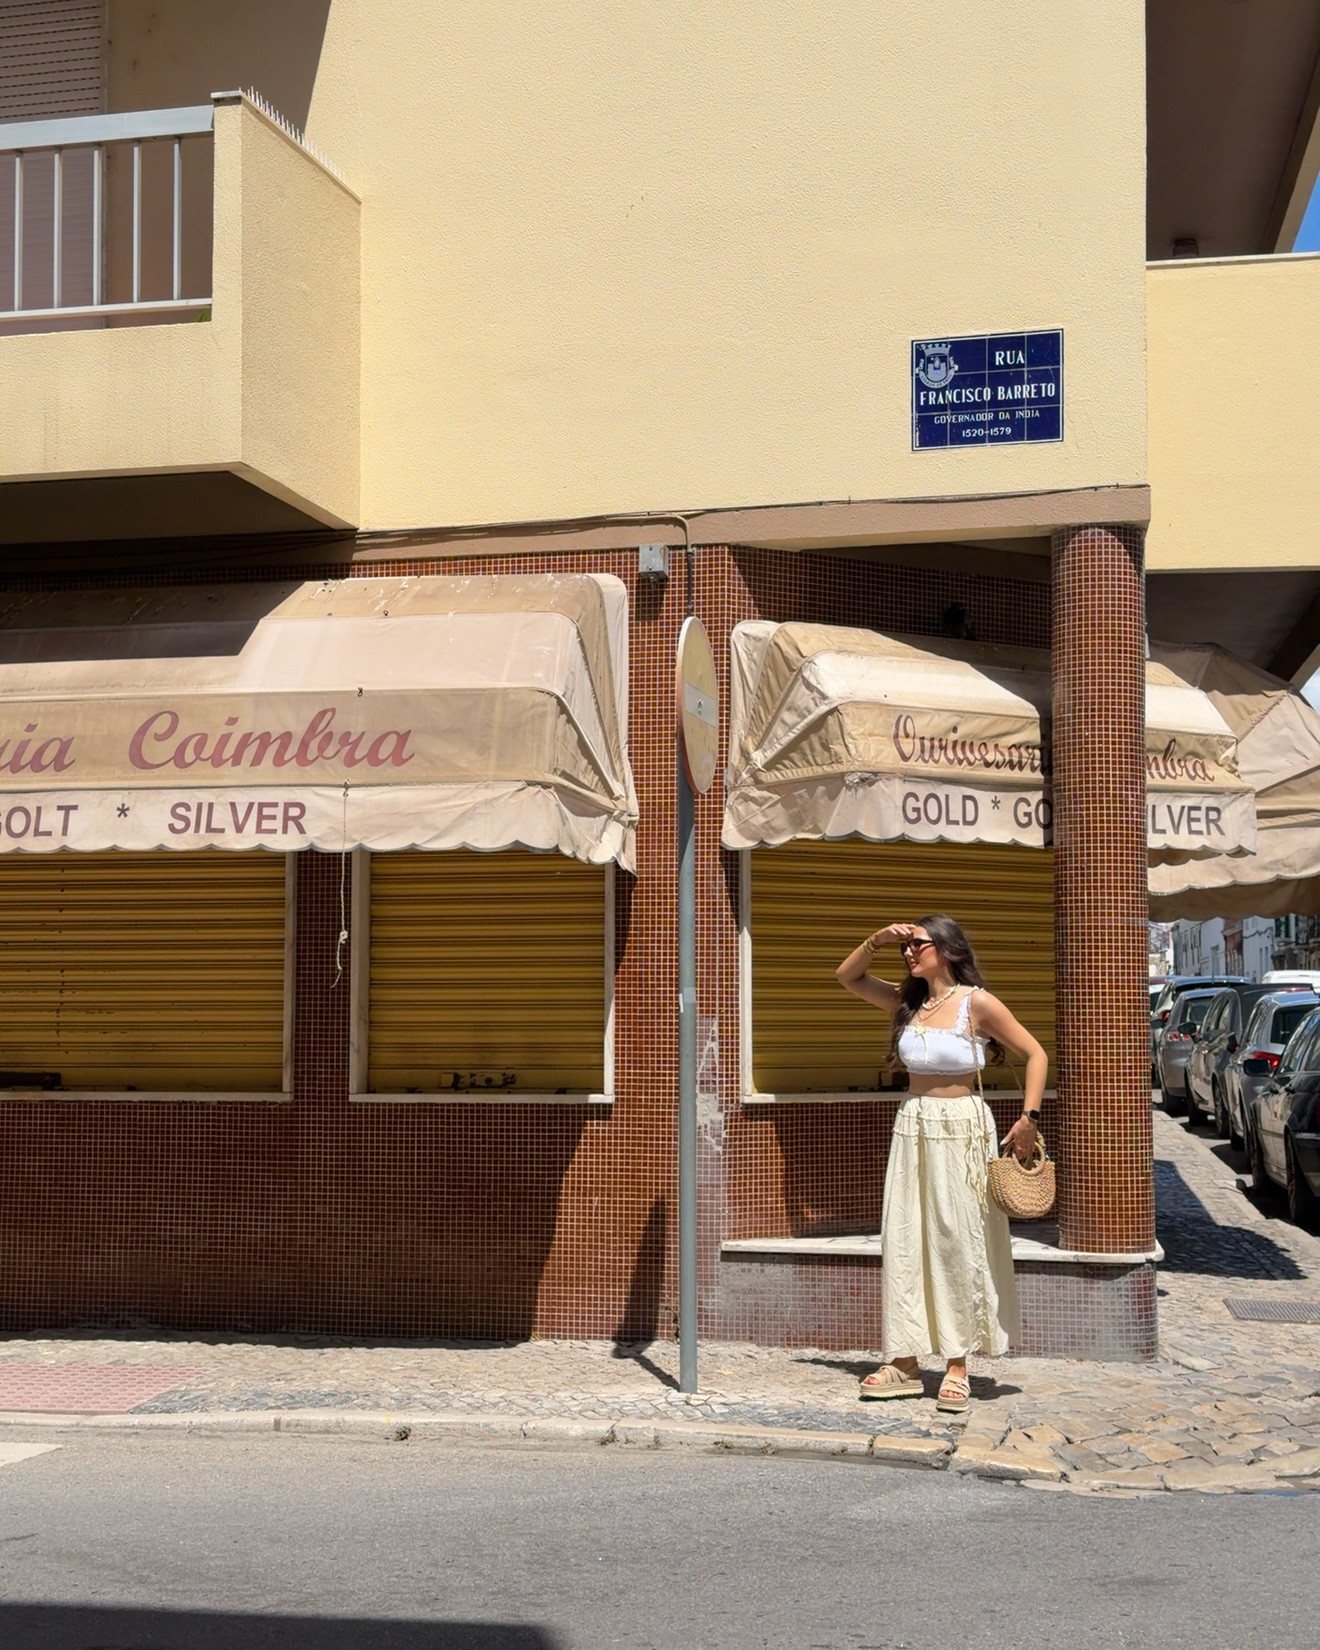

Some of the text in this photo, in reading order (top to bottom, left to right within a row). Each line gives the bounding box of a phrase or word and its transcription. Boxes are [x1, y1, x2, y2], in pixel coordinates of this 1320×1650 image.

[995, 350, 1025, 366] RUA
[920, 383, 1056, 406] FRANCISCO BARRETO
[934, 410, 1040, 425] GOVERNADOR DA INDIA
[962, 427, 1012, 437] 1520-1579
[128, 707, 415, 771] Coimbra
[893, 714, 1053, 774] Ourivesari
[0, 801, 307, 839] OLT SILVER
[902, 791, 979, 827] GOLD
[1013, 796, 1053, 830] GO
